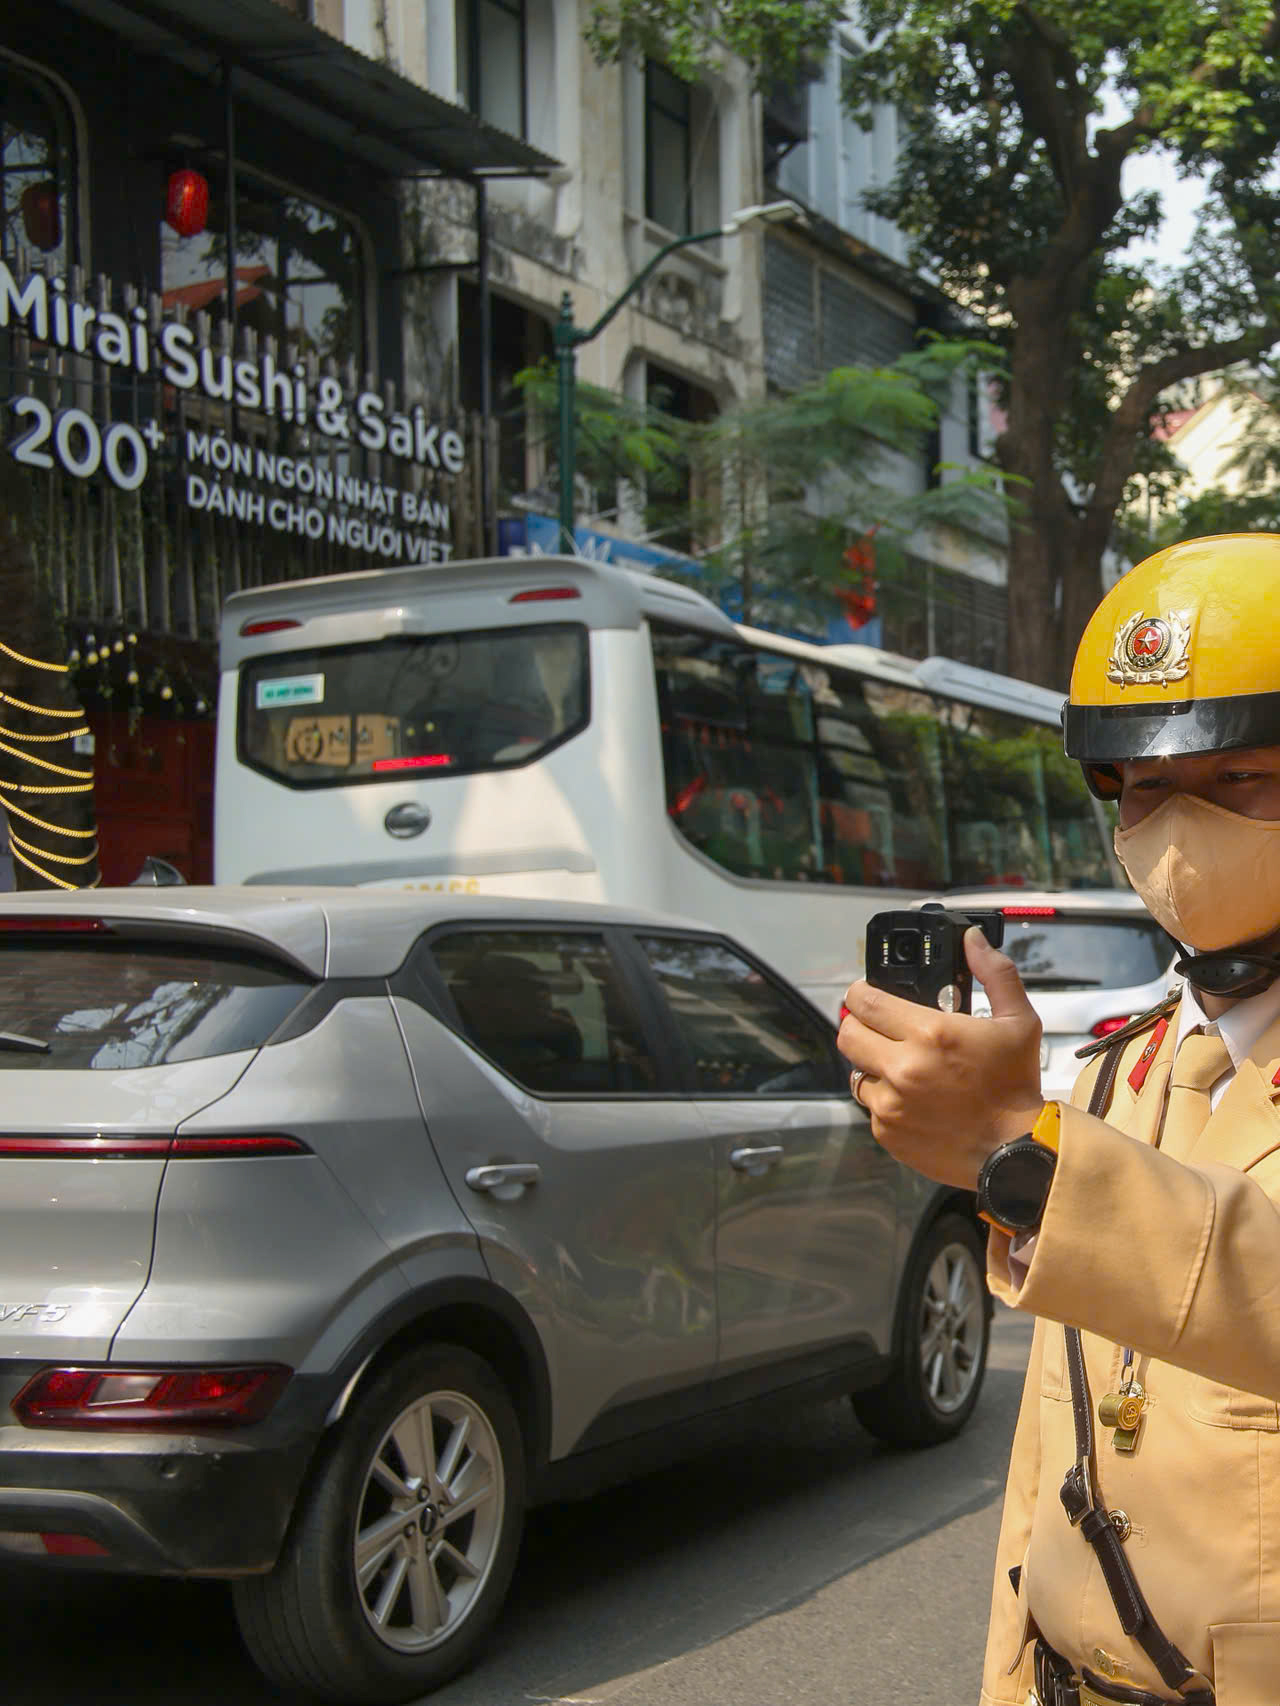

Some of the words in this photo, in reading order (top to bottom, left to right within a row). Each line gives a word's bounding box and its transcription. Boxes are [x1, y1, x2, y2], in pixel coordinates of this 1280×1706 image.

[0, 259, 148, 373] Mirai
[162, 322, 308, 426] Sushi
[315, 376, 350, 439] &
[358, 392, 465, 474] Sake
[268, 499, 325, 540] CHO
